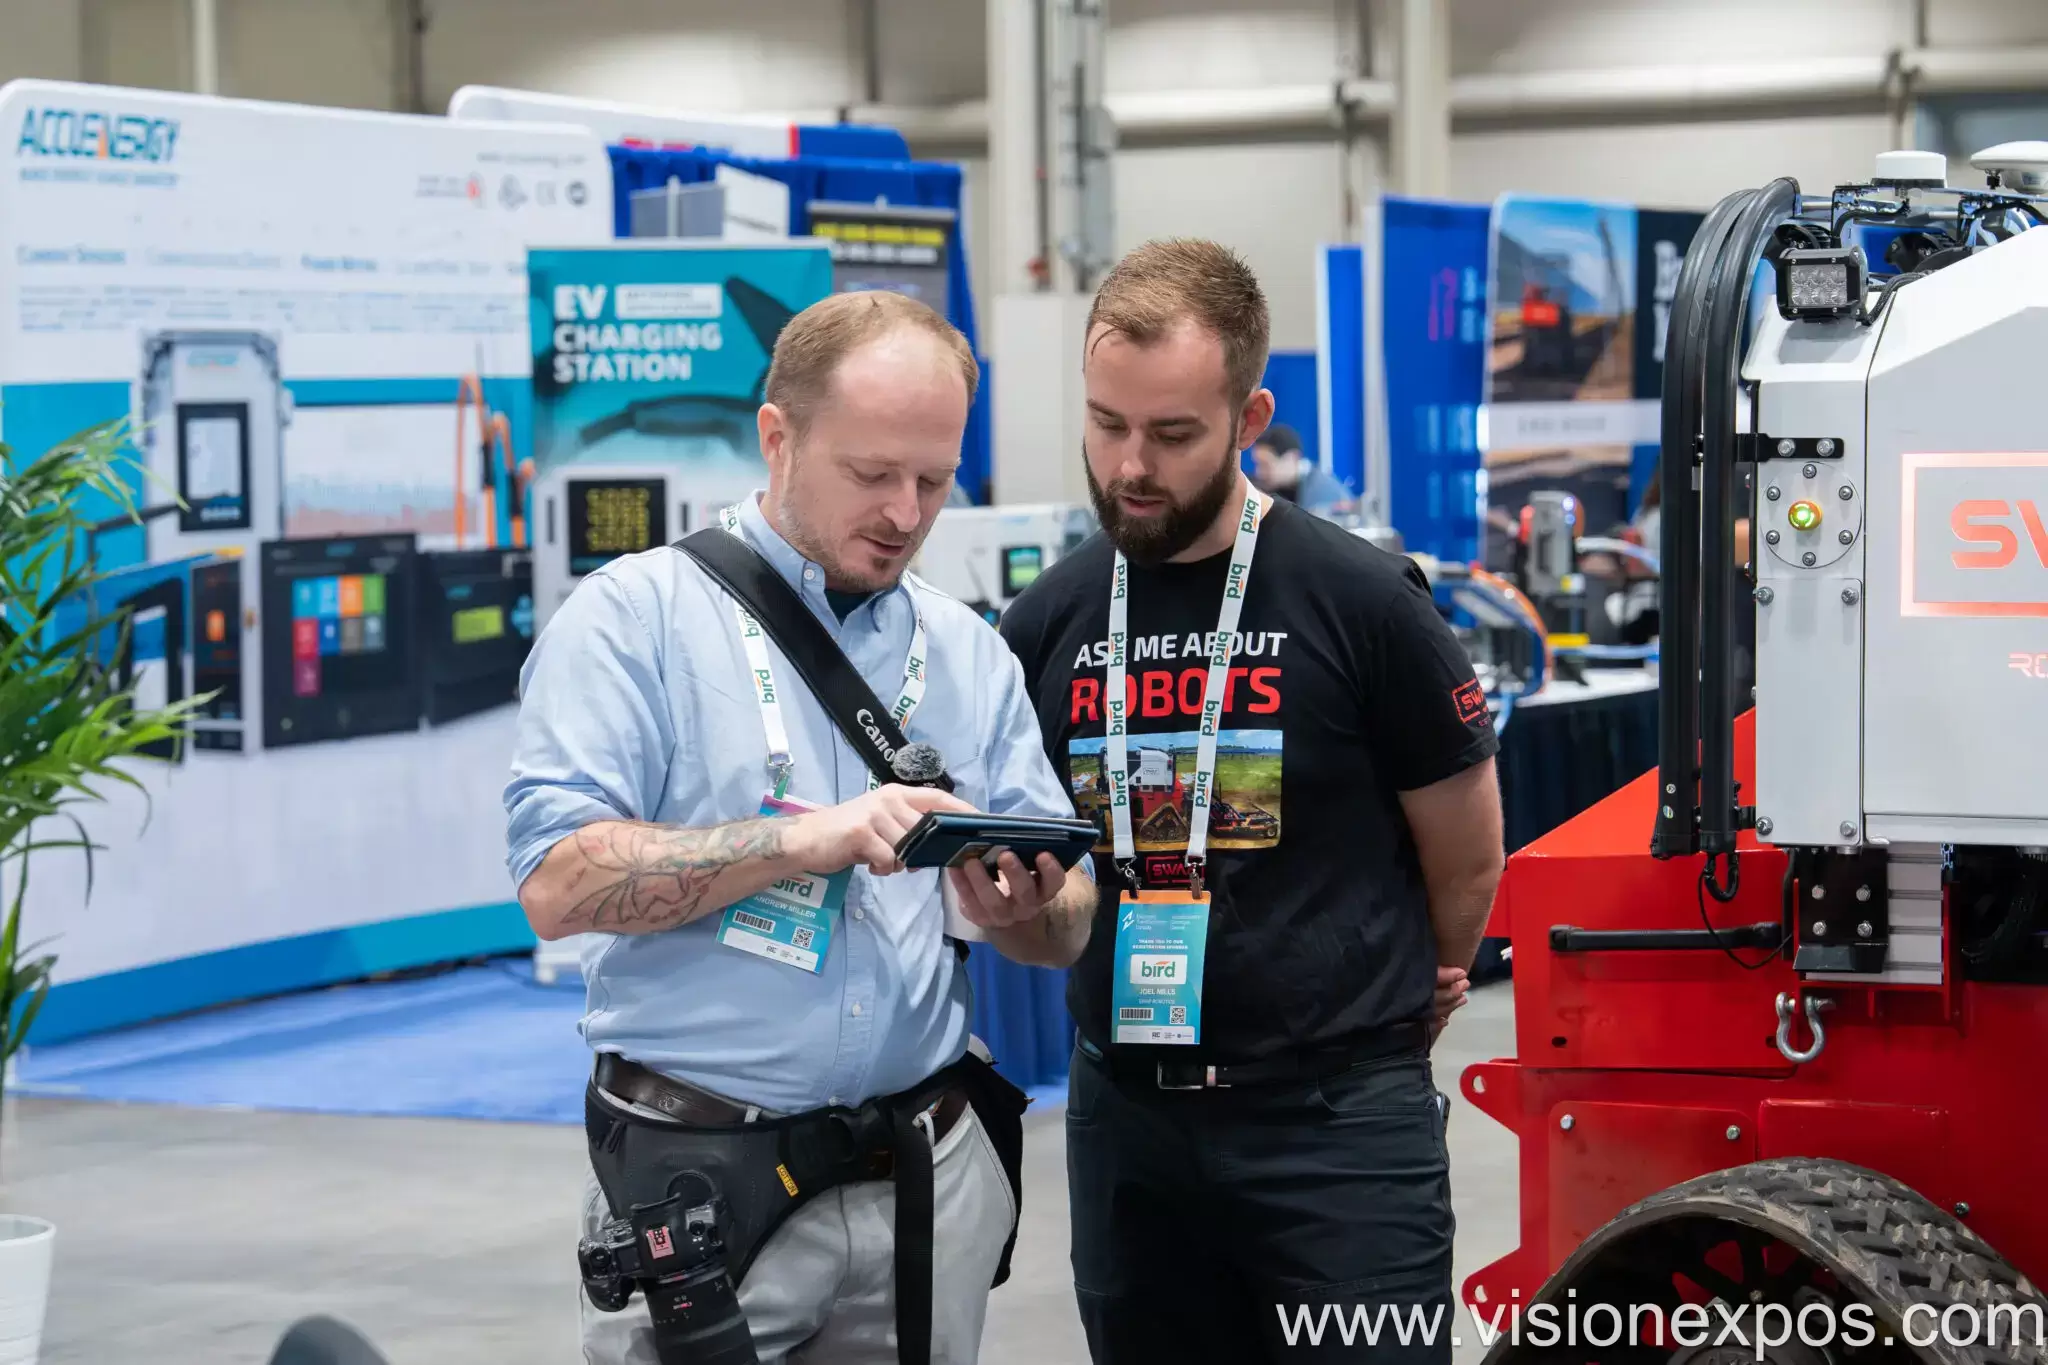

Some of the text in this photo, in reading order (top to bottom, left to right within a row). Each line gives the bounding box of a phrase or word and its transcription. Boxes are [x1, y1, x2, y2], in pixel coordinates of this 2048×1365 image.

[554, 284, 607, 320] EV
[554, 322, 722, 352] CHARGING
[554, 353, 692, 383] STATION
[1241, 498, 1259, 534] bird
[1113, 564, 1126, 600] bird
[1226, 563, 1248, 599] bird
[1110, 632, 1125, 667] bird
[1134, 634, 1177, 662] ME
[1212, 631, 1232, 666] bird
[755, 669, 775, 704] bird
[857, 708, 896, 762] Cano
[1109, 700, 1123, 736] bird
[1202, 700, 1219, 736] bird
[1111, 770, 1127, 806] bird
[1195, 771, 1211, 808] bird
[754, 895, 788, 910] ANDREW
[788, 904, 816, 919] MILLER
[1141, 960, 1176, 978] bird
[1156, 988, 1177, 996] MILLS
